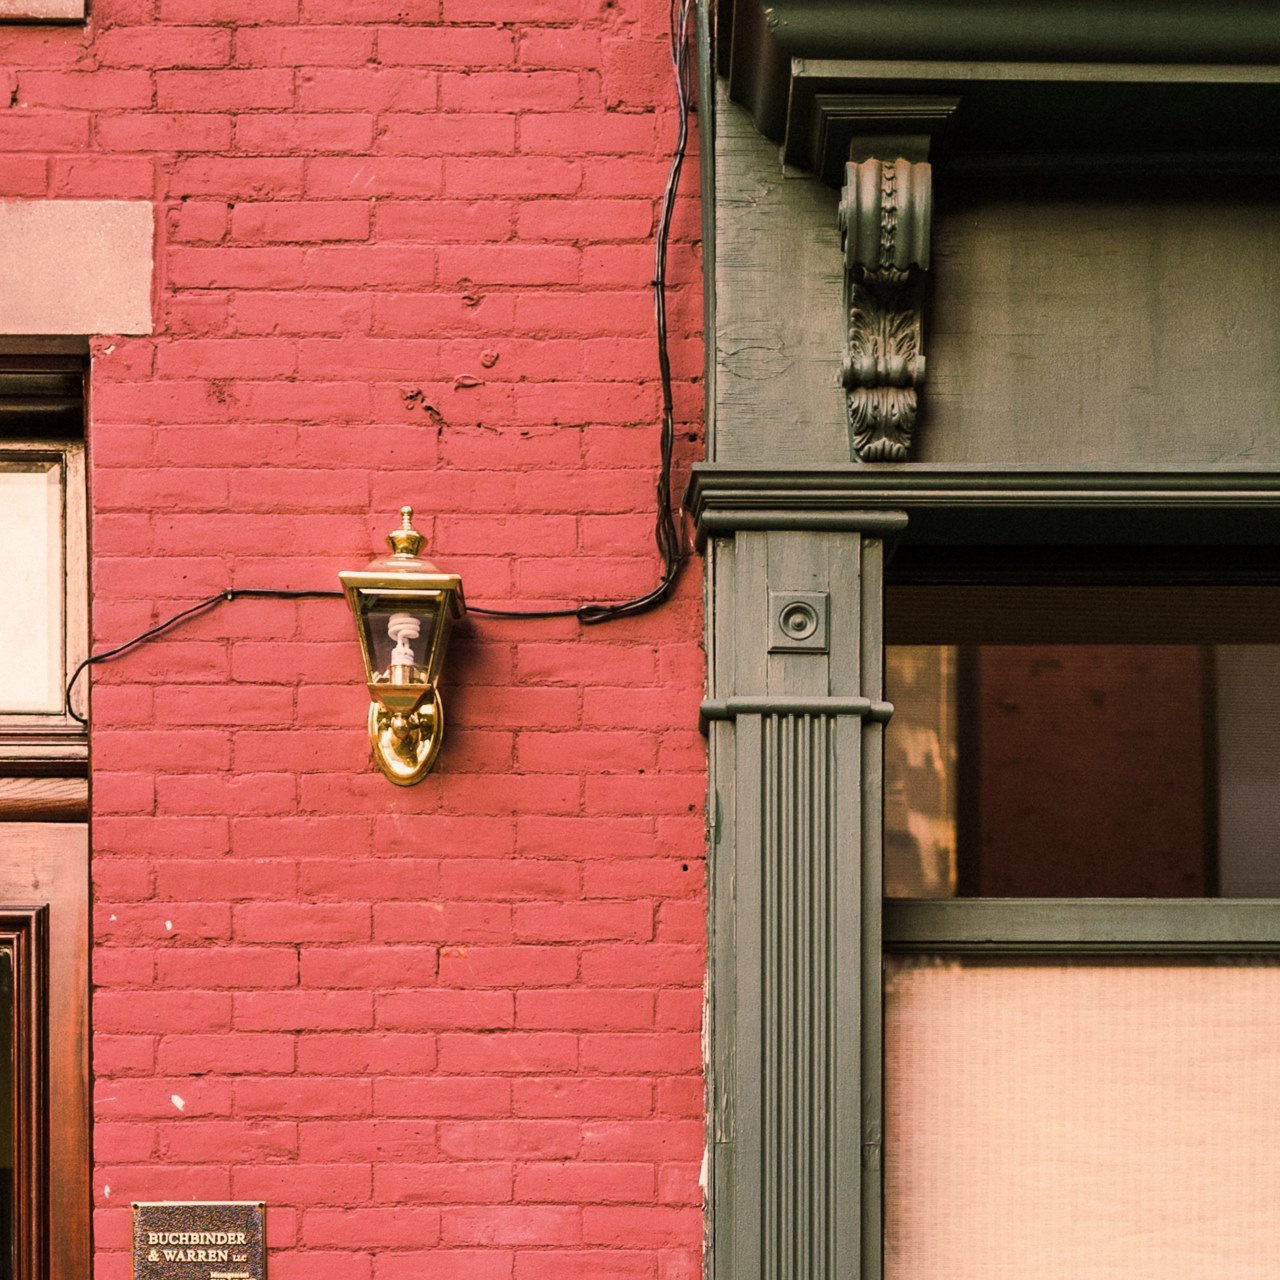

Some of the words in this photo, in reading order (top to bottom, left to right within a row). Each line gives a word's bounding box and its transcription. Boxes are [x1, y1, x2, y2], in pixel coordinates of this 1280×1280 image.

[148, 1232, 246, 1244] BUCHBINDER
[148, 1250, 160, 1262] &
[163, 1250, 229, 1262] WARREN
[232, 1254, 248, 1262] LLC
